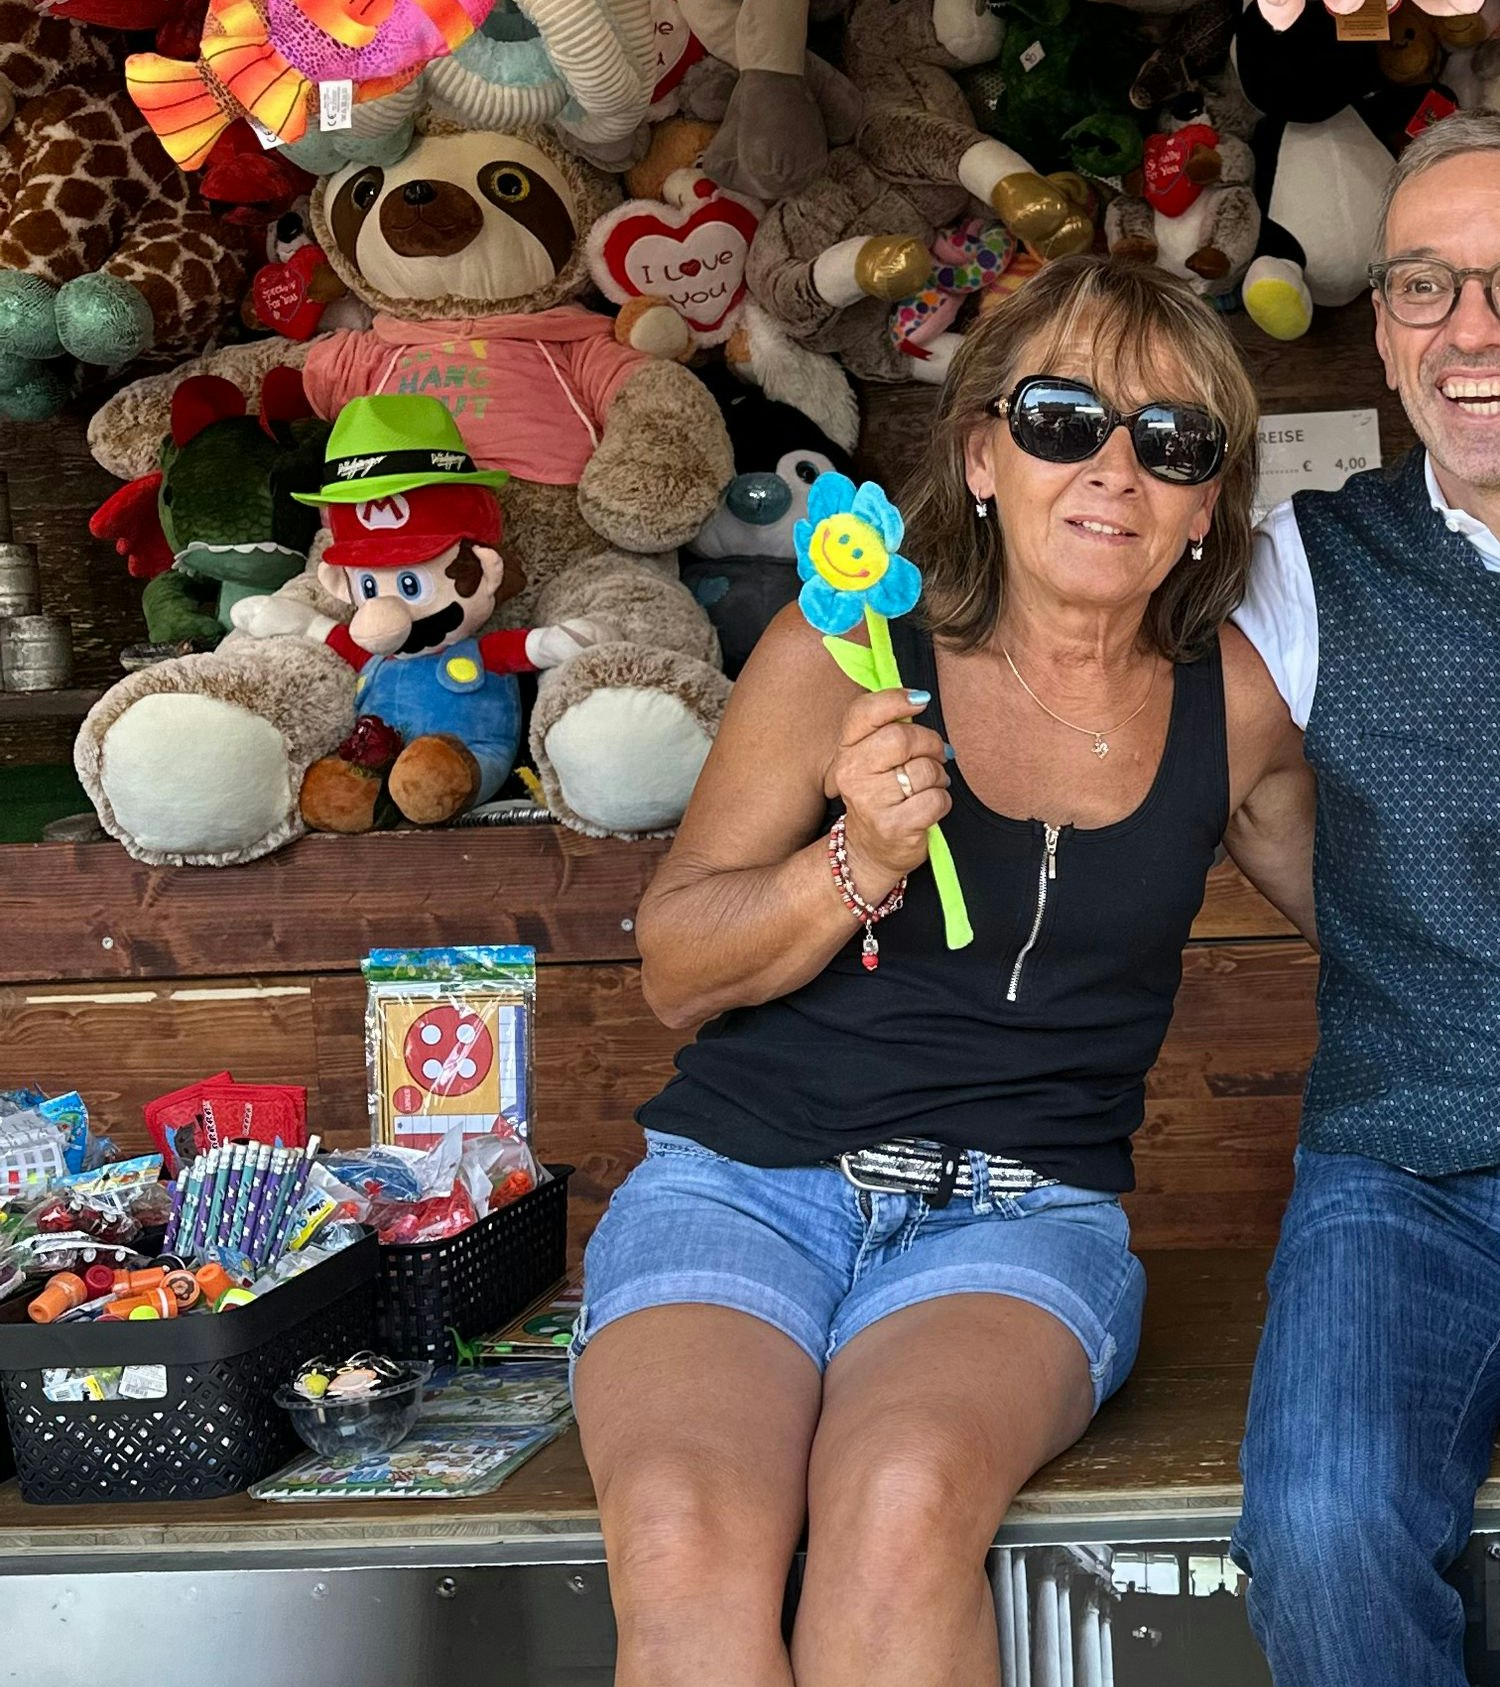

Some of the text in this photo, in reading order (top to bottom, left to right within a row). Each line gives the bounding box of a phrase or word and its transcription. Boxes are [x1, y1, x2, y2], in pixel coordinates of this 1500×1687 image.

[641, 265, 653, 284] I
[398, 365, 489, 394] HANG
[440, 395, 494, 419] UT
[1257, 429, 1304, 444] REISE
[1302, 456, 1367, 472] € 4,00
[363, 495, 404, 522] M
